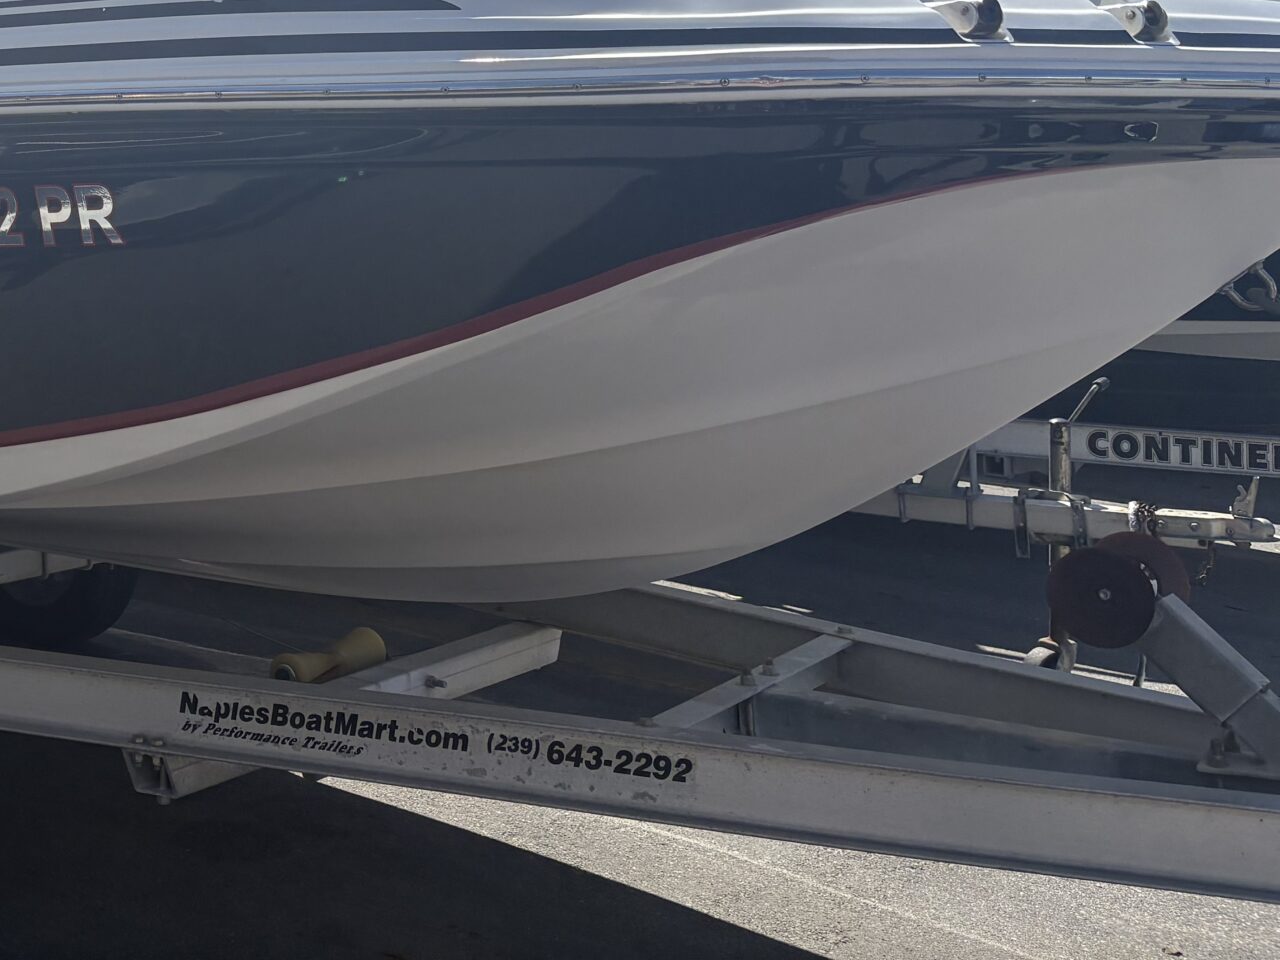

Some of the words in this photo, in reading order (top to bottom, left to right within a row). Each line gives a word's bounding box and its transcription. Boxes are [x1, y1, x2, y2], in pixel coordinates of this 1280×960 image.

[33, 183, 124, 247] PR
[179, 691, 469, 752] NaplesBoatMart.com
[486, 733, 541, 759] (239)
[547, 740, 693, 783] 643-2292
[181, 720, 202, 734] by
[202, 723, 298, 746] Performance
[301, 736, 364, 755] Trailers
